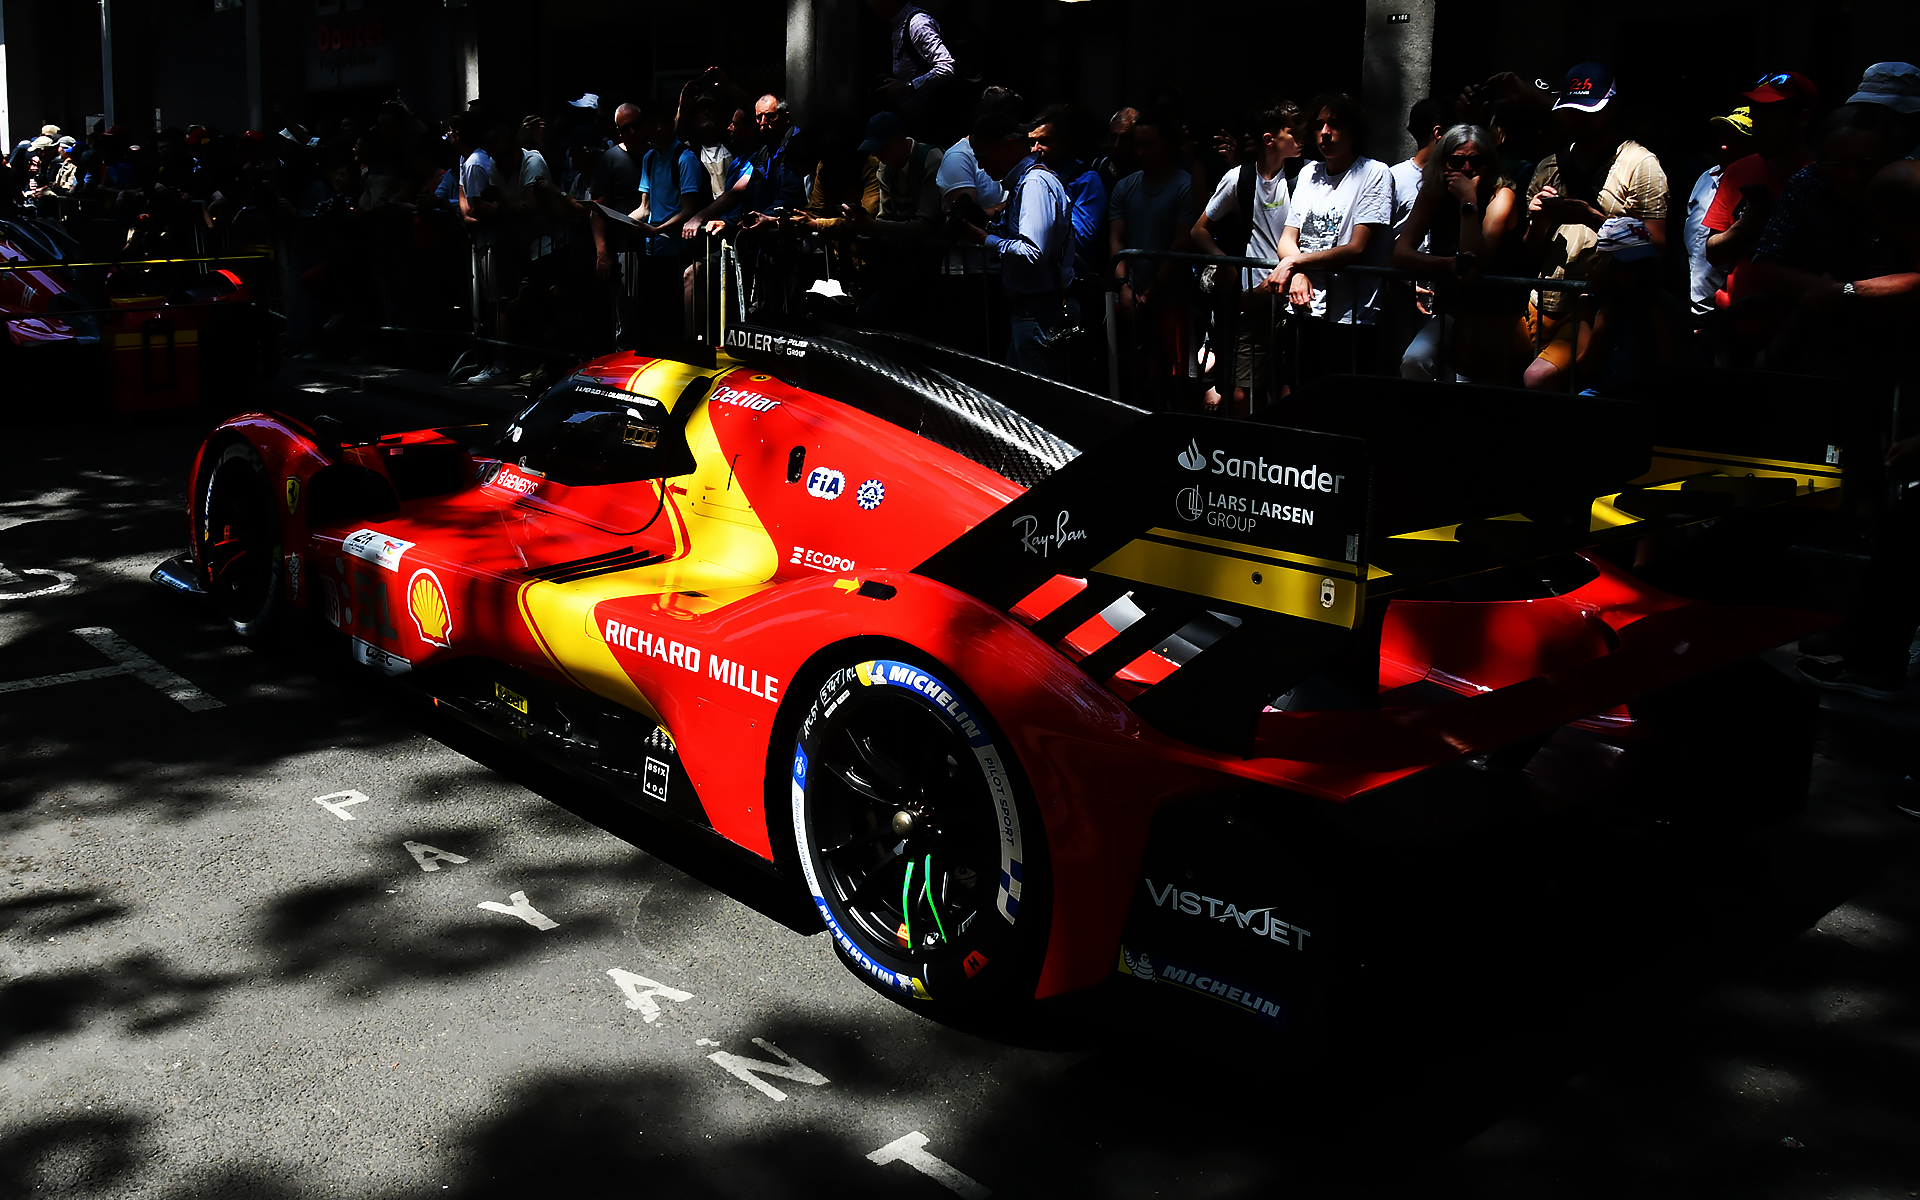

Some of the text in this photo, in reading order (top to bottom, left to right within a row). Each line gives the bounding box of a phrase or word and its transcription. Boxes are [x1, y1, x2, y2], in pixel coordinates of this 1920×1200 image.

[317, 19, 386, 52] Doucet
[725, 329, 772, 352] ADLER
[709, 386, 781, 412] Cetilar
[504, 473, 538, 495] GENESYS
[1211, 449, 1346, 494] Santander
[1206, 510, 1257, 533] GROUP
[1208, 491, 1314, 526] LARS LARSEN
[353, 570, 398, 641] 51
[365, 645, 393, 666] WEC
[605, 618, 701, 673] RICHARD
[708, 653, 779, 704] MILLE
[888, 665, 981, 739] MICHELIN
[984, 757, 1015, 847] PILOT SPORT
[1144, 877, 1312, 952] VISTAJET
[818, 904, 895, 987] MICHELIN
[1162, 964, 1281, 1018] MICHELIN
